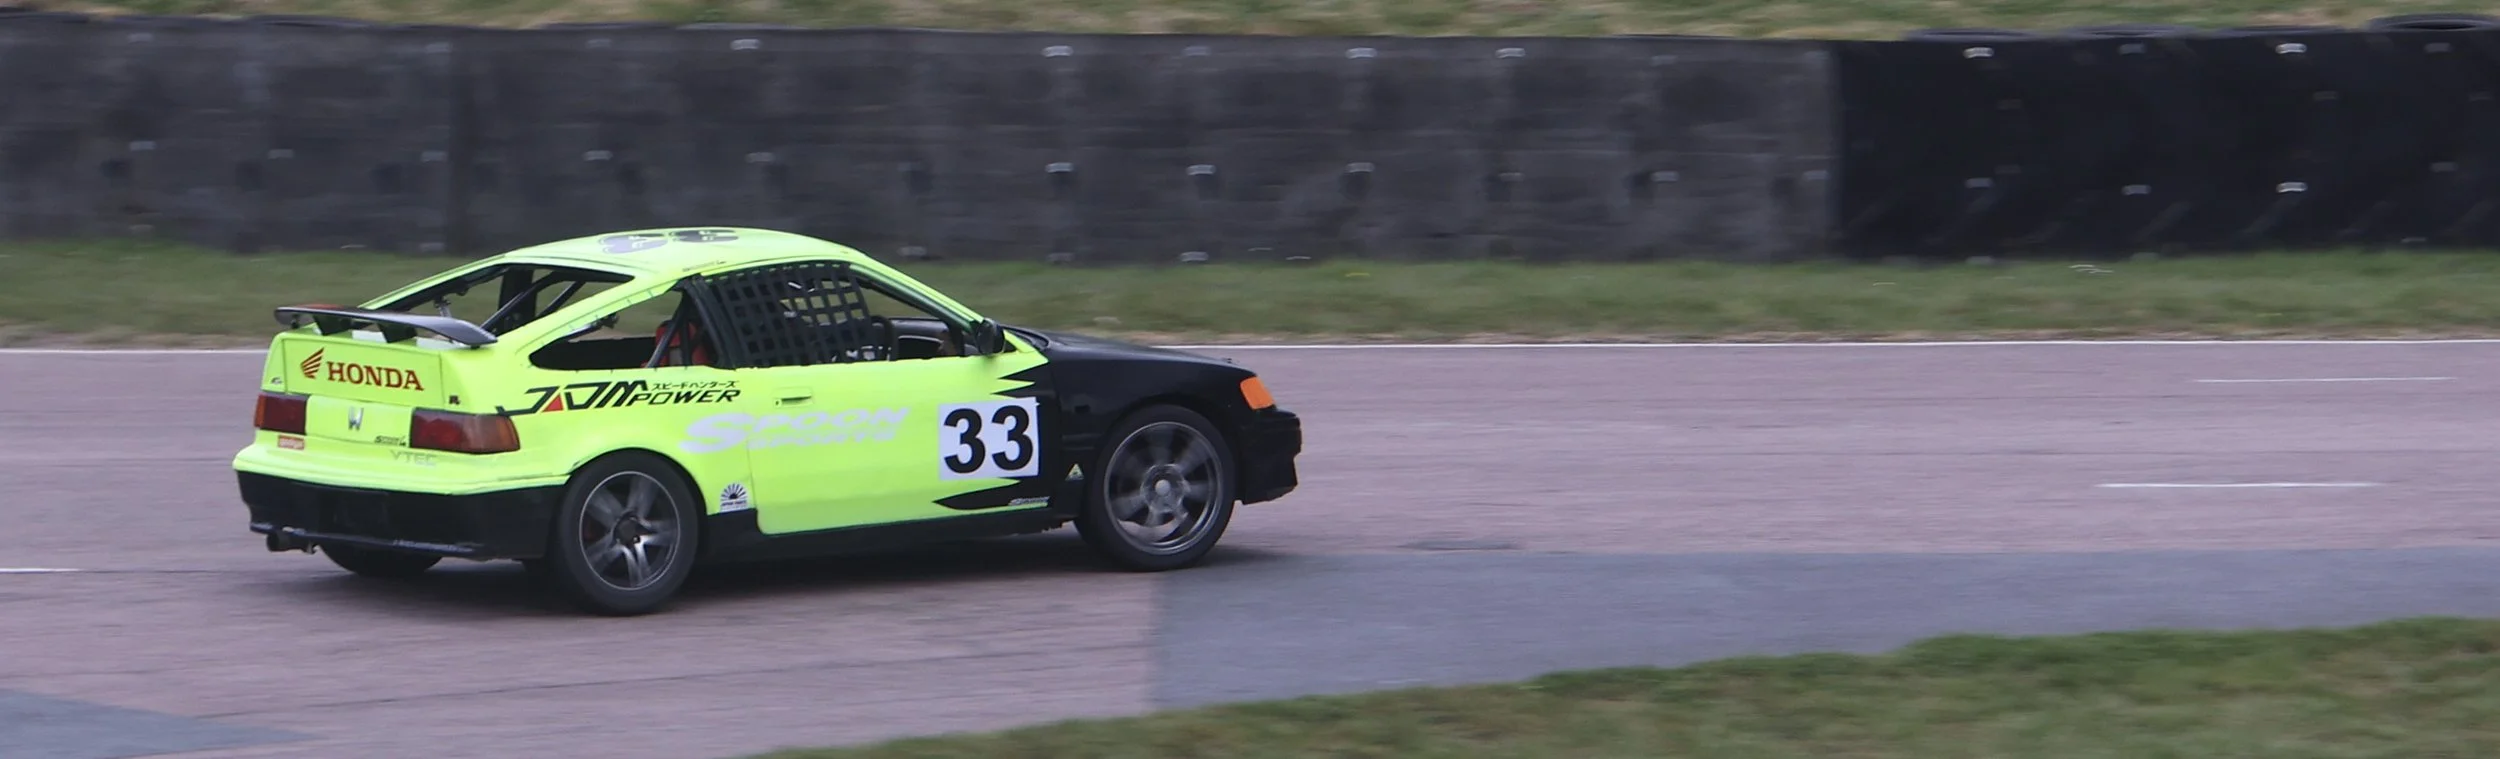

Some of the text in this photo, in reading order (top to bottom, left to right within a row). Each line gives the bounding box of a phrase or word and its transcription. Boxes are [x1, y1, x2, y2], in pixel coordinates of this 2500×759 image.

[326, 361, 425, 391] HONDA
[651, 380, 740, 391] スピードハンターズ
[628, 389, 742, 407] POWER
[943, 404, 1034, 474] 33
